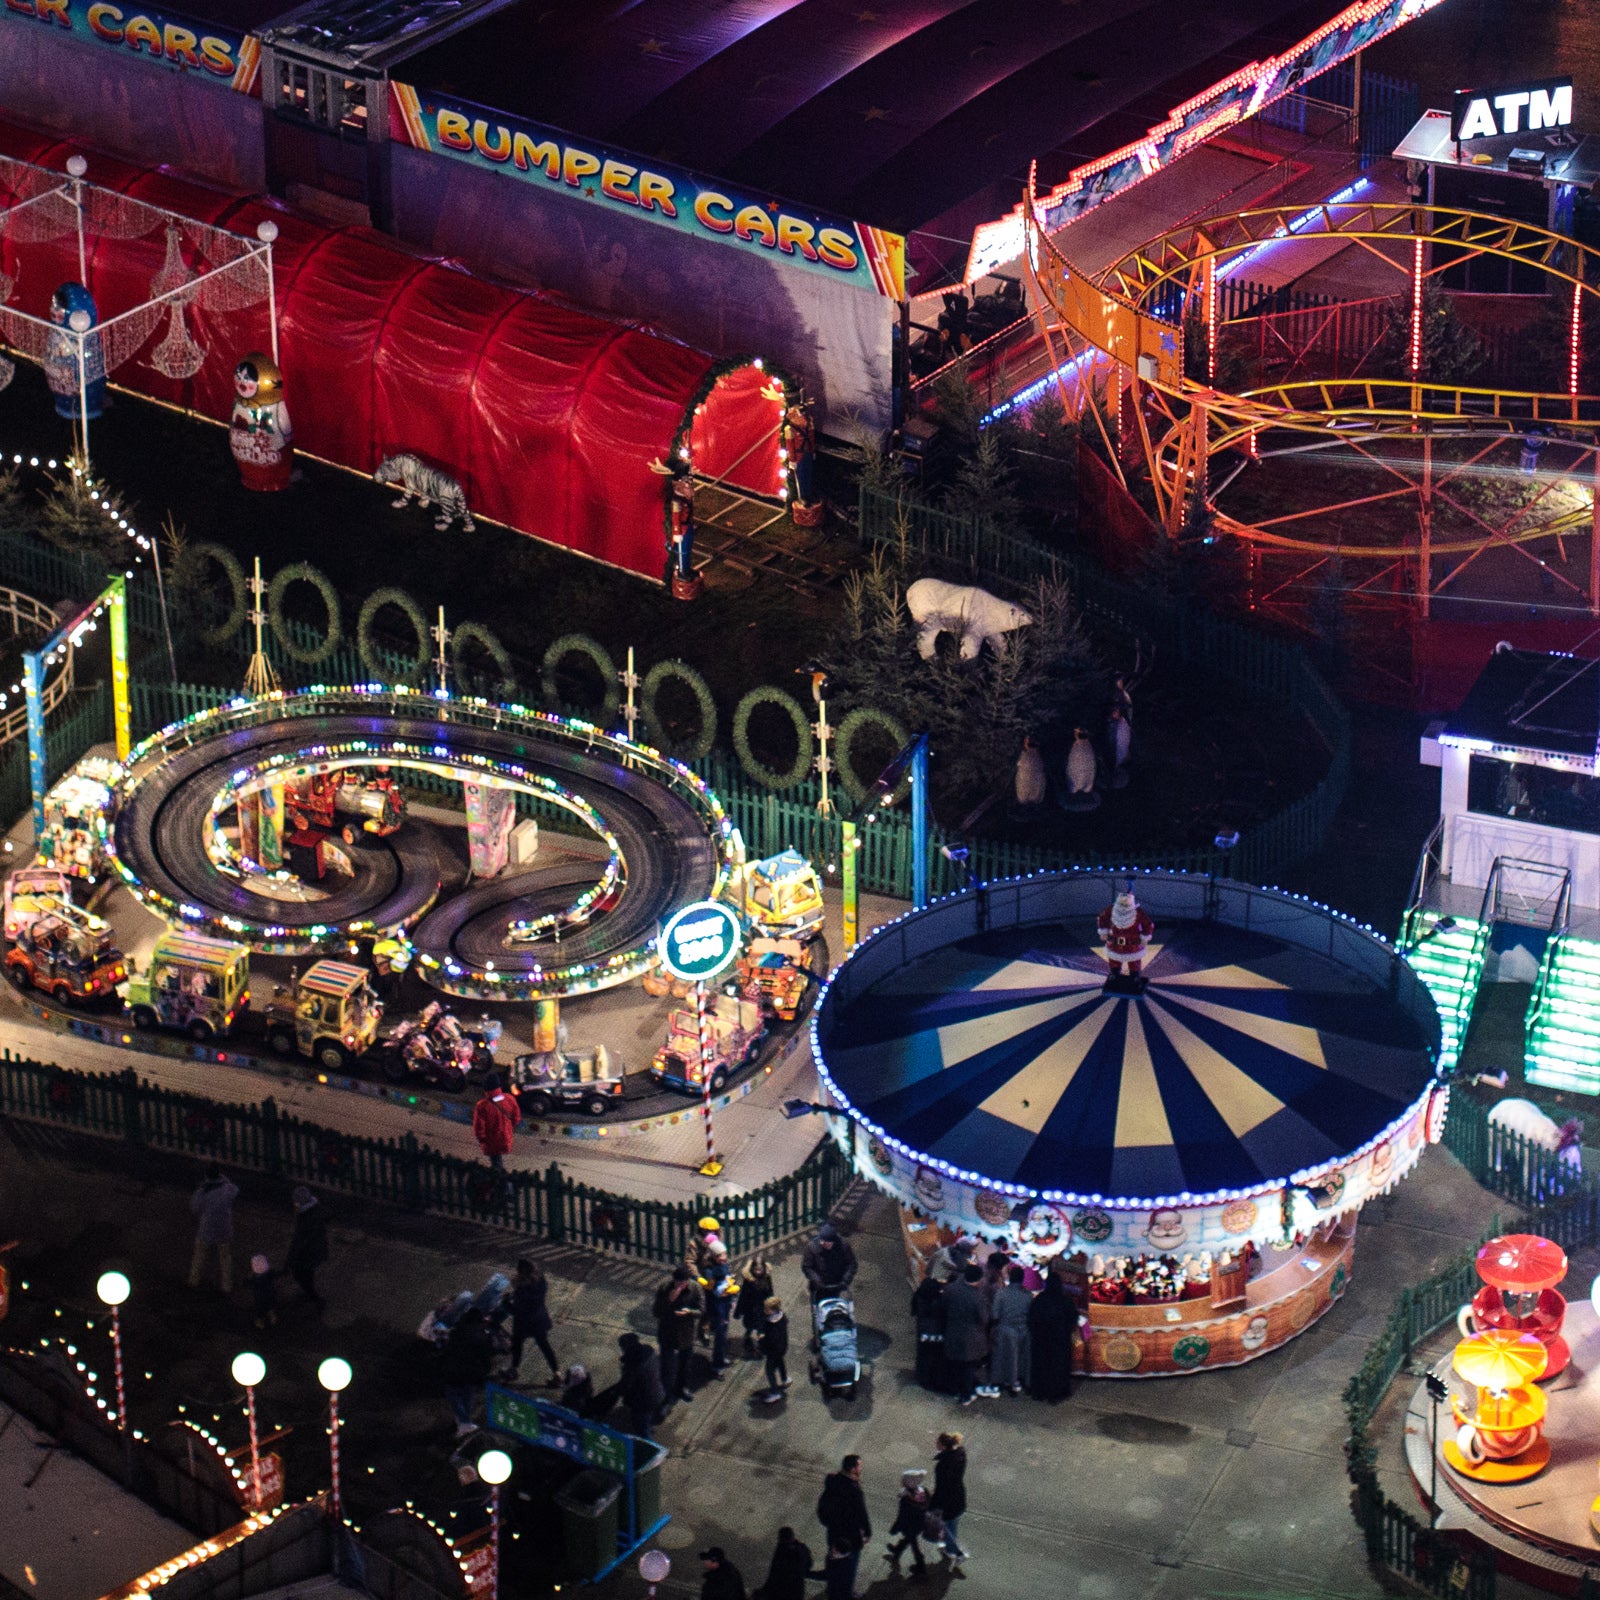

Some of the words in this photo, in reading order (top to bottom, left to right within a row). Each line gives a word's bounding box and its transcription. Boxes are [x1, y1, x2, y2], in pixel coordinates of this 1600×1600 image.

[87, 2, 236, 76] CARS
[1458, 87, 1573, 140] ATM
[436, 108, 678, 218] BUMPER
[693, 190, 858, 271] CARS
